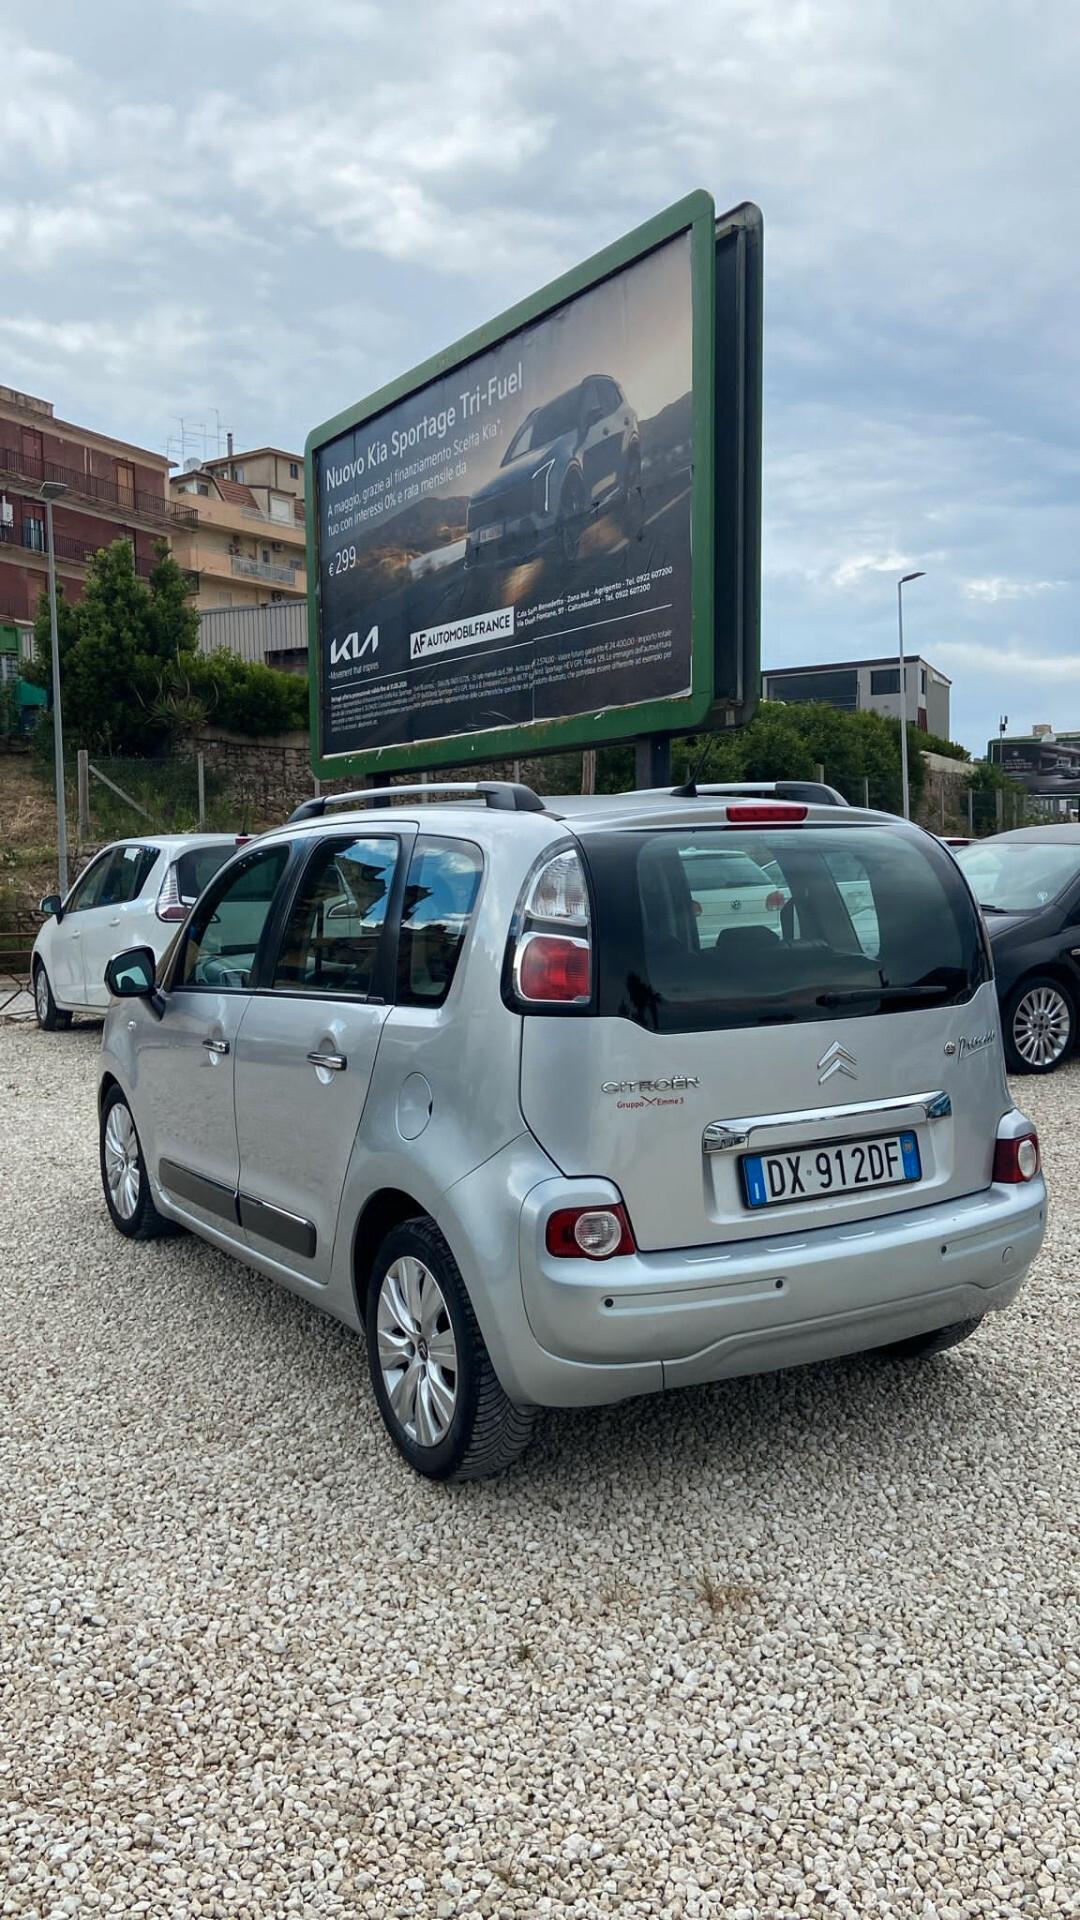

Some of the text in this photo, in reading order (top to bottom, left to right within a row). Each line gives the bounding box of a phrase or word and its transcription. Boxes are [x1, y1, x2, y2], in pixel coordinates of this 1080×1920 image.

[326, 361, 522, 492] Nuovo Kia Sportage Tri-Fuel
[327, 504, 333, 519] A
[334, 491, 361, 514] maggio,
[362, 480, 385, 505] grazie
[385, 472, 393, 489] al
[395, 447, 452, 485] finanziamento
[453, 432, 480, 456] Scelta
[328, 461, 467, 537] tuo con interessi 0% e rata mensile da
[328, 545, 357, 577] € 299
[567, 594, 580, 603] Zona
[594, 582, 622, 596] Agrigento
[635, 573, 651, 584] 0922
[651, 566, 673, 579] 607200
[615, 589, 629, 600] 0922
[629, 583, 651, 596] 607200
[413, 614, 511, 655] AF AUTOMOBILFRANCE
[601, 1074, 700, 1094] CITROËN
[616, 1100, 644, 1110] Gruppo
[766, 1156, 806, 1198] DX
[815, 1141, 899, 1189] 912DF
